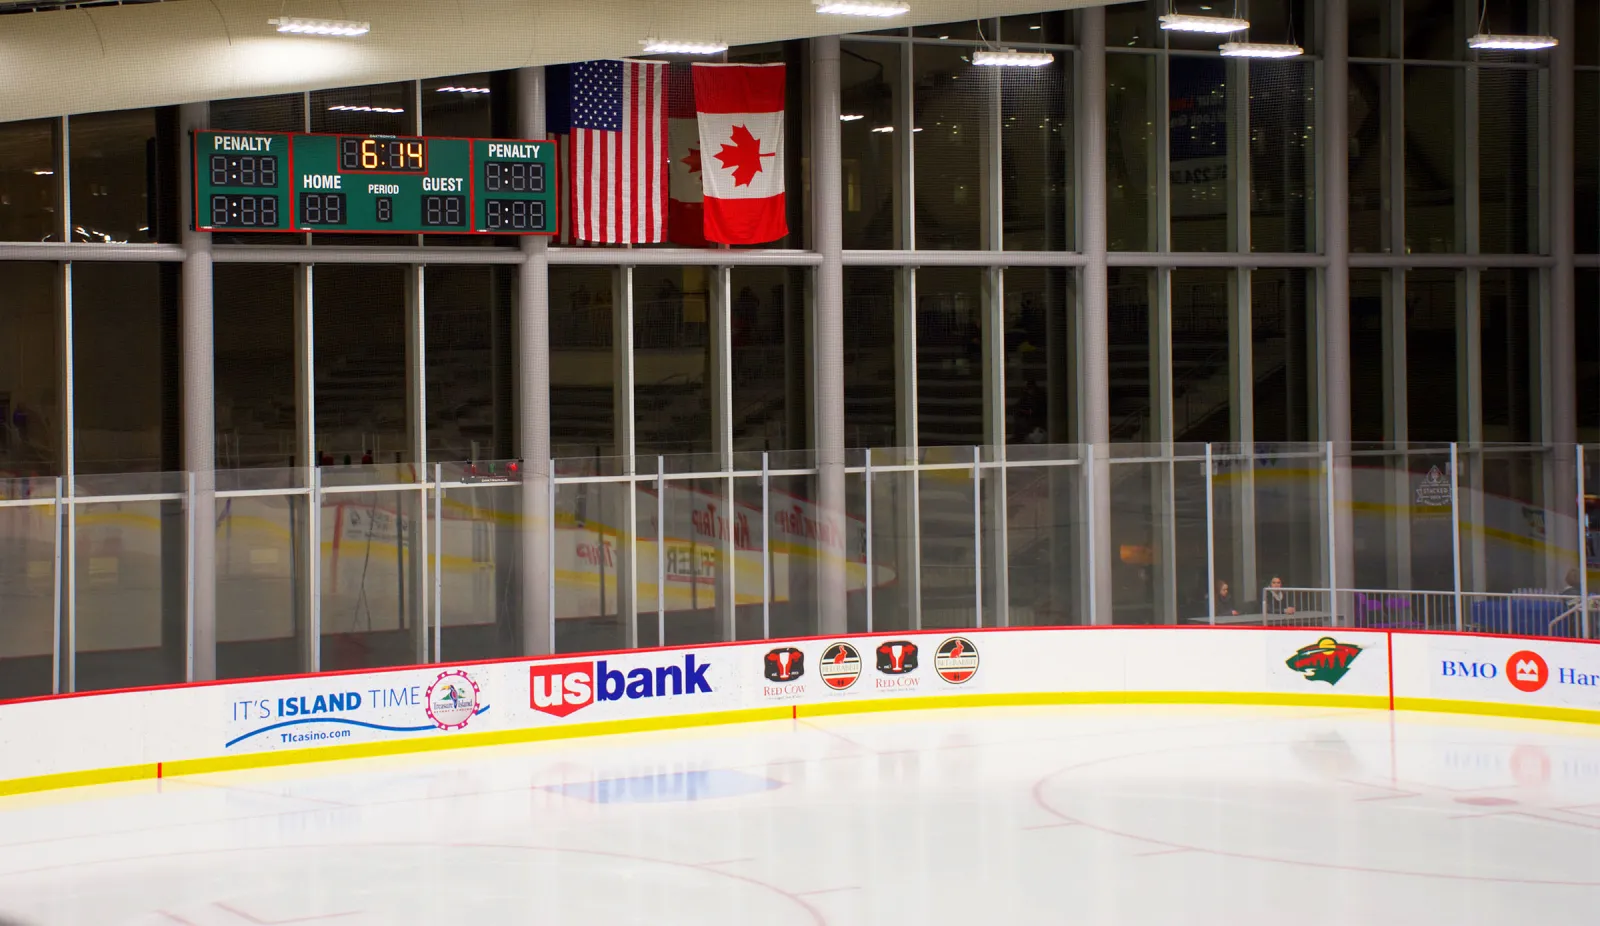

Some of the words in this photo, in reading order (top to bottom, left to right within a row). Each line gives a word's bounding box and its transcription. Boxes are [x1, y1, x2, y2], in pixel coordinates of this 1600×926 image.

[214, 135, 272, 151] PENALTY
[488, 143, 540, 159] PENALTY
[361, 139, 423, 169] 6:14
[303, 174, 342, 189] HOME
[368, 184, 400, 195] PERIOD
[422, 177, 464, 192] GUEST
[1441, 660, 1498, 679] BMO
[1558, 667, 1600, 687] Har
[232, 699, 271, 721] IT'S
[277, 691, 362, 717] ISLAND
[368, 686, 421, 708] TIME
[281, 729, 351, 743] TIcasino.com
